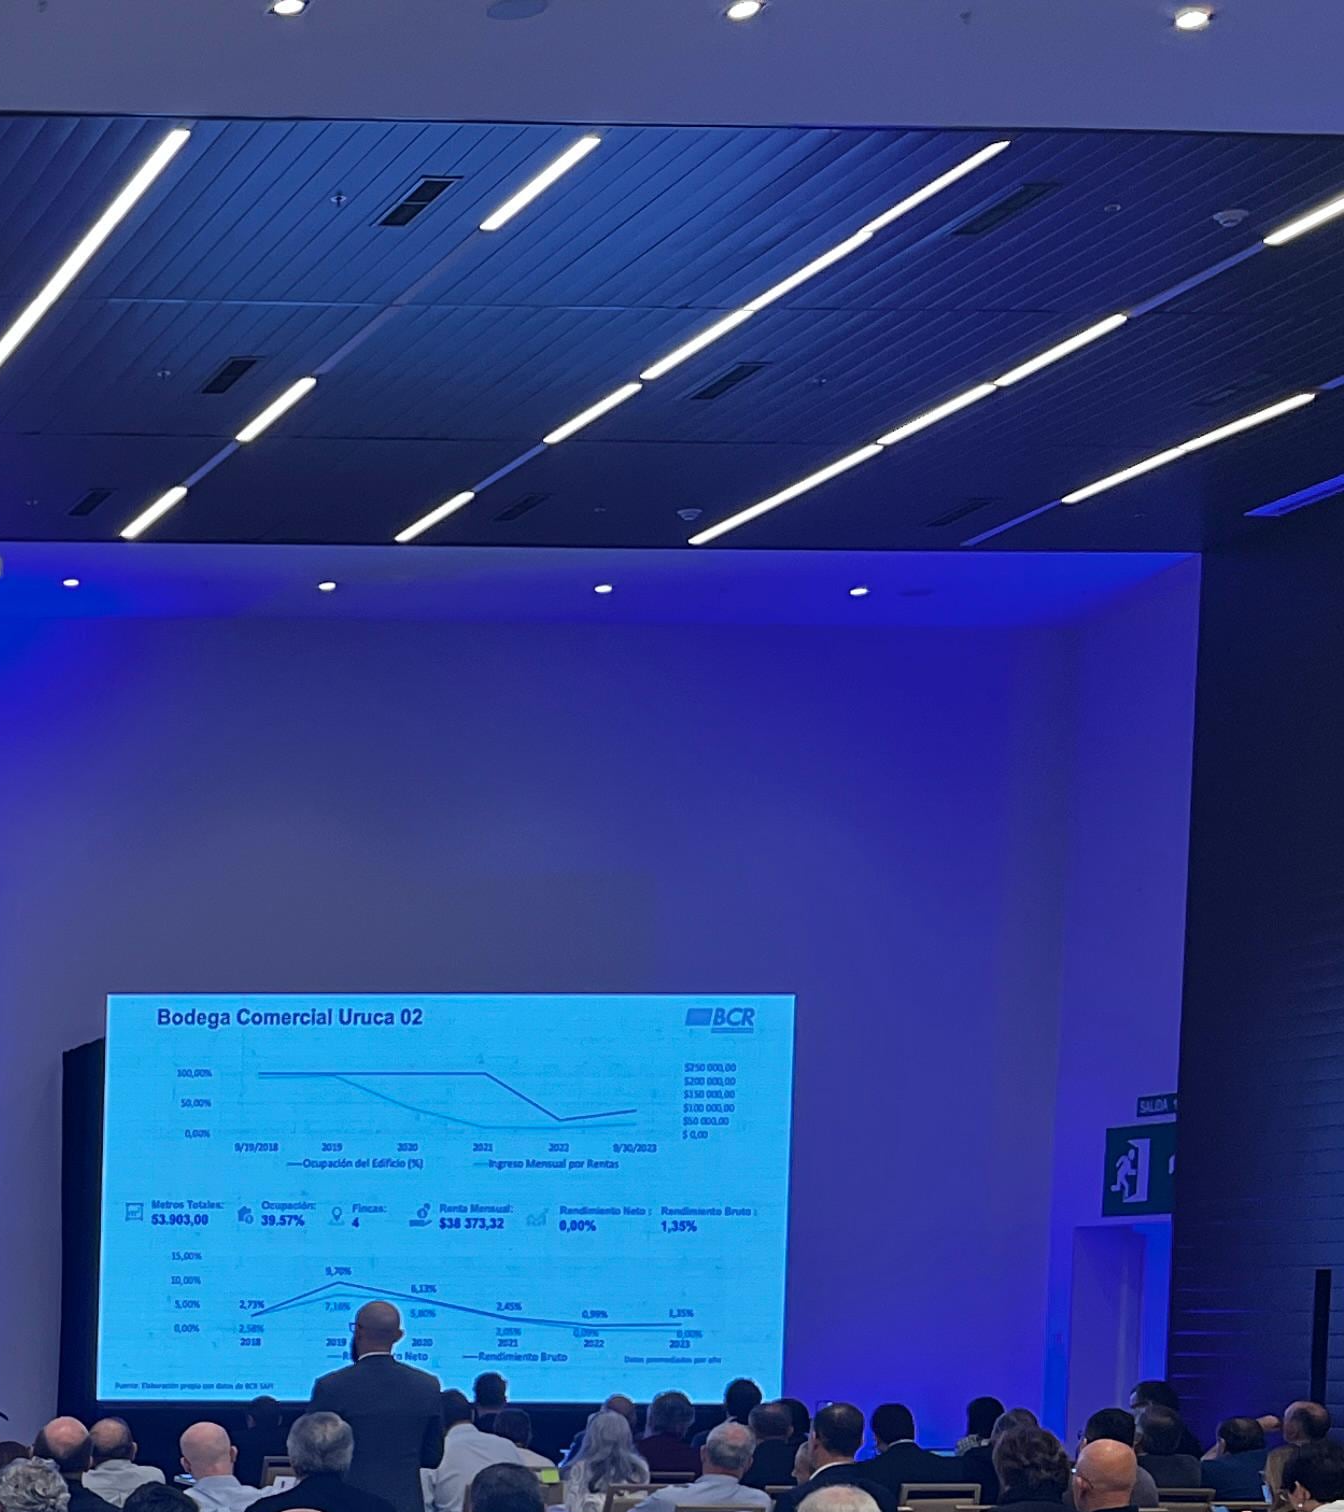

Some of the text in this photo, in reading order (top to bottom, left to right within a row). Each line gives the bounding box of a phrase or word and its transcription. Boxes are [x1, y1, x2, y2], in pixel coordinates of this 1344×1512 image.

[157, 1009, 422, 1029] Bodega Comercial Uruca 02
[713, 1008, 755, 1025] BCR
[1140, 1098, 1168, 1113] SALIDA
[303, 1158, 352, 1170] Ocupación
[355, 1159, 369, 1168] del
[372, 1159, 405, 1169] Edificio
[489, 1159, 619, 1171] Ingreso Mensual por Rentas
[152, 1201, 184, 1210] Metros
[560, 1207, 621, 1215] Rendimiento
[661, 1207, 722, 1216] Rendimiento
[152, 1215, 208, 1226] 53.903,00
[261, 1216, 304, 1226] 39.57%
[352, 1218, 359, 1228] 4
[661, 1221, 696, 1233] 1,35%
[405, 1352, 428, 1361] Neto
[479, 1352, 567, 1362] Rendimiento Bruto
